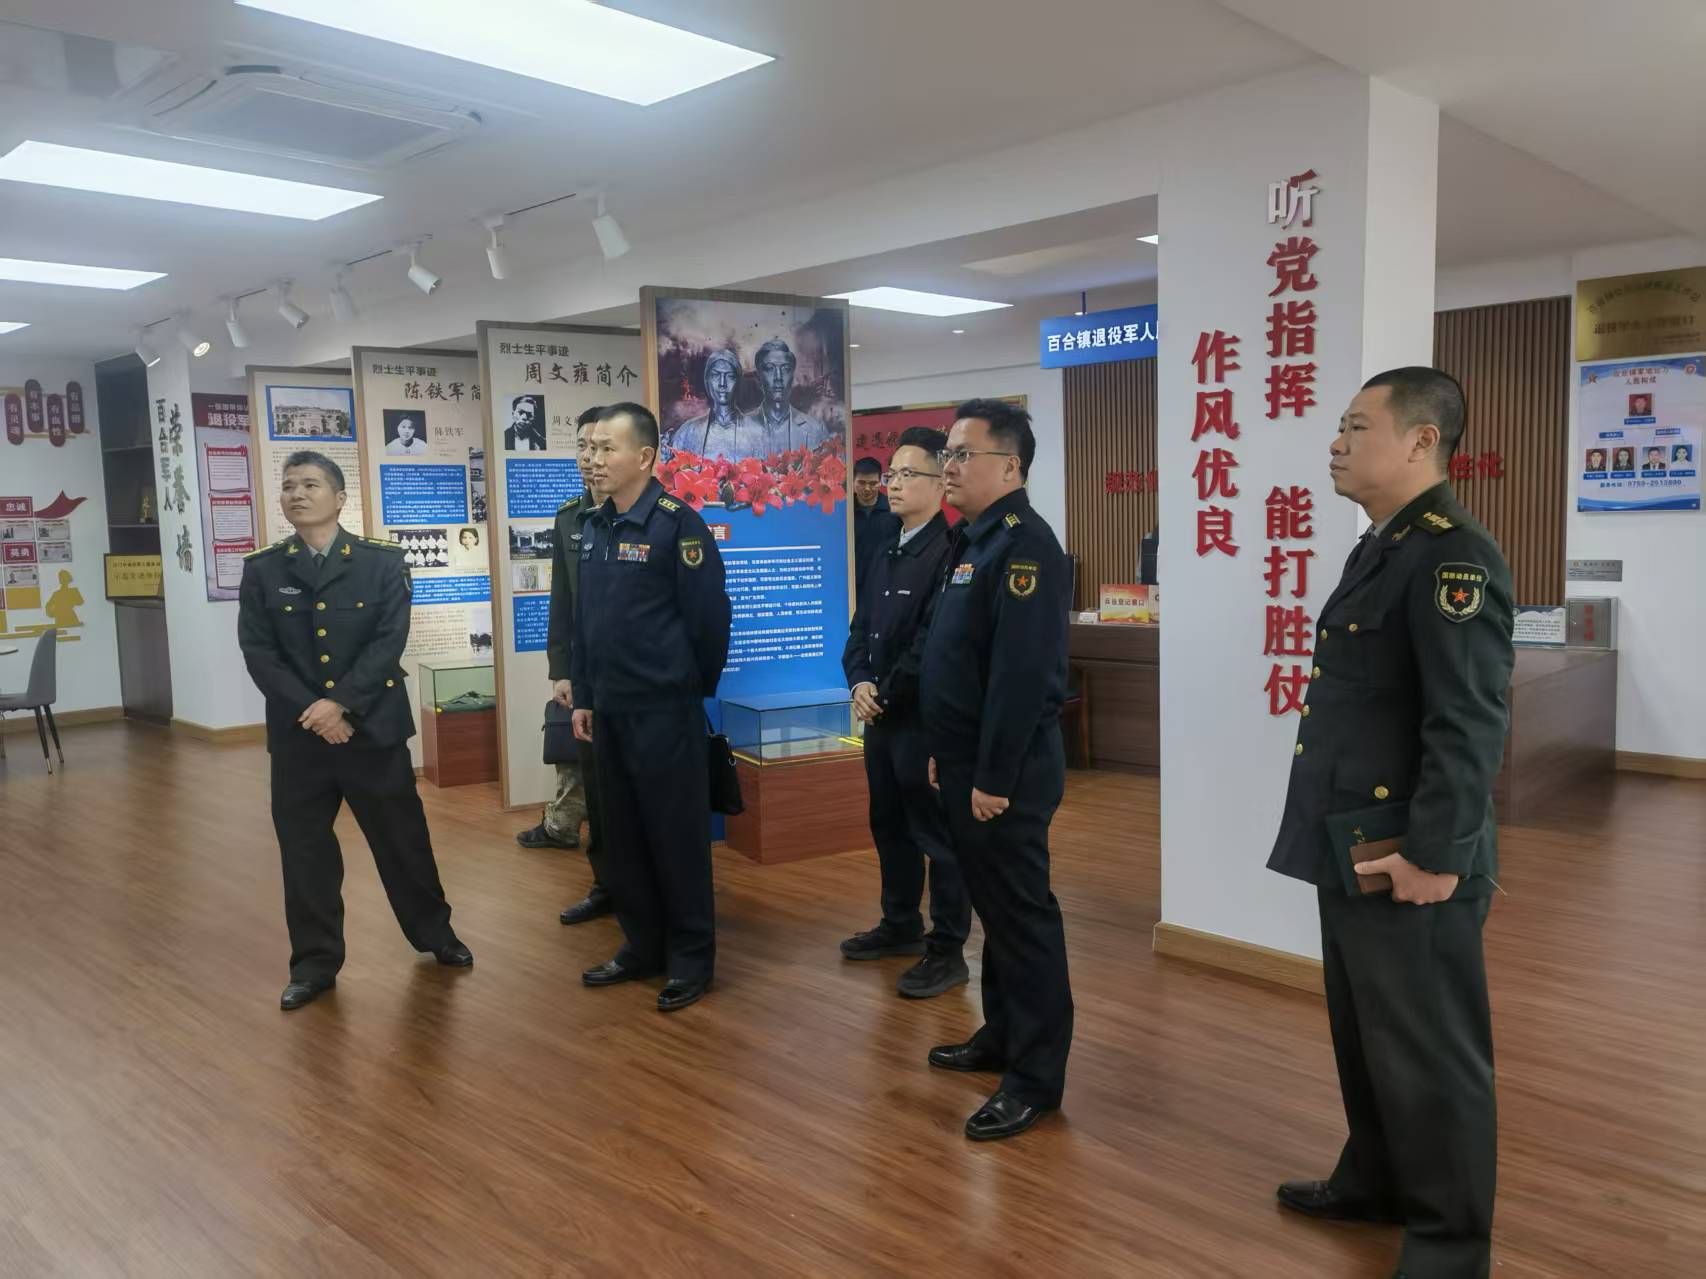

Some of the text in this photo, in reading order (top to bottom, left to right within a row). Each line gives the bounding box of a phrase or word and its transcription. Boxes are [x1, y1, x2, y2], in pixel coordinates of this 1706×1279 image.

[499, 342, 570, 357] 烈士生平事迹
[1047, 320, 1158, 353] 百合镇退役军人
[525, 361, 638, 388] 周文雍简介
[1191, 329, 1241, 557] 作风优良
[1263, 169, 1320, 716] 听党指挥 能打胜仗
[706, 525, 726, 540] 言
